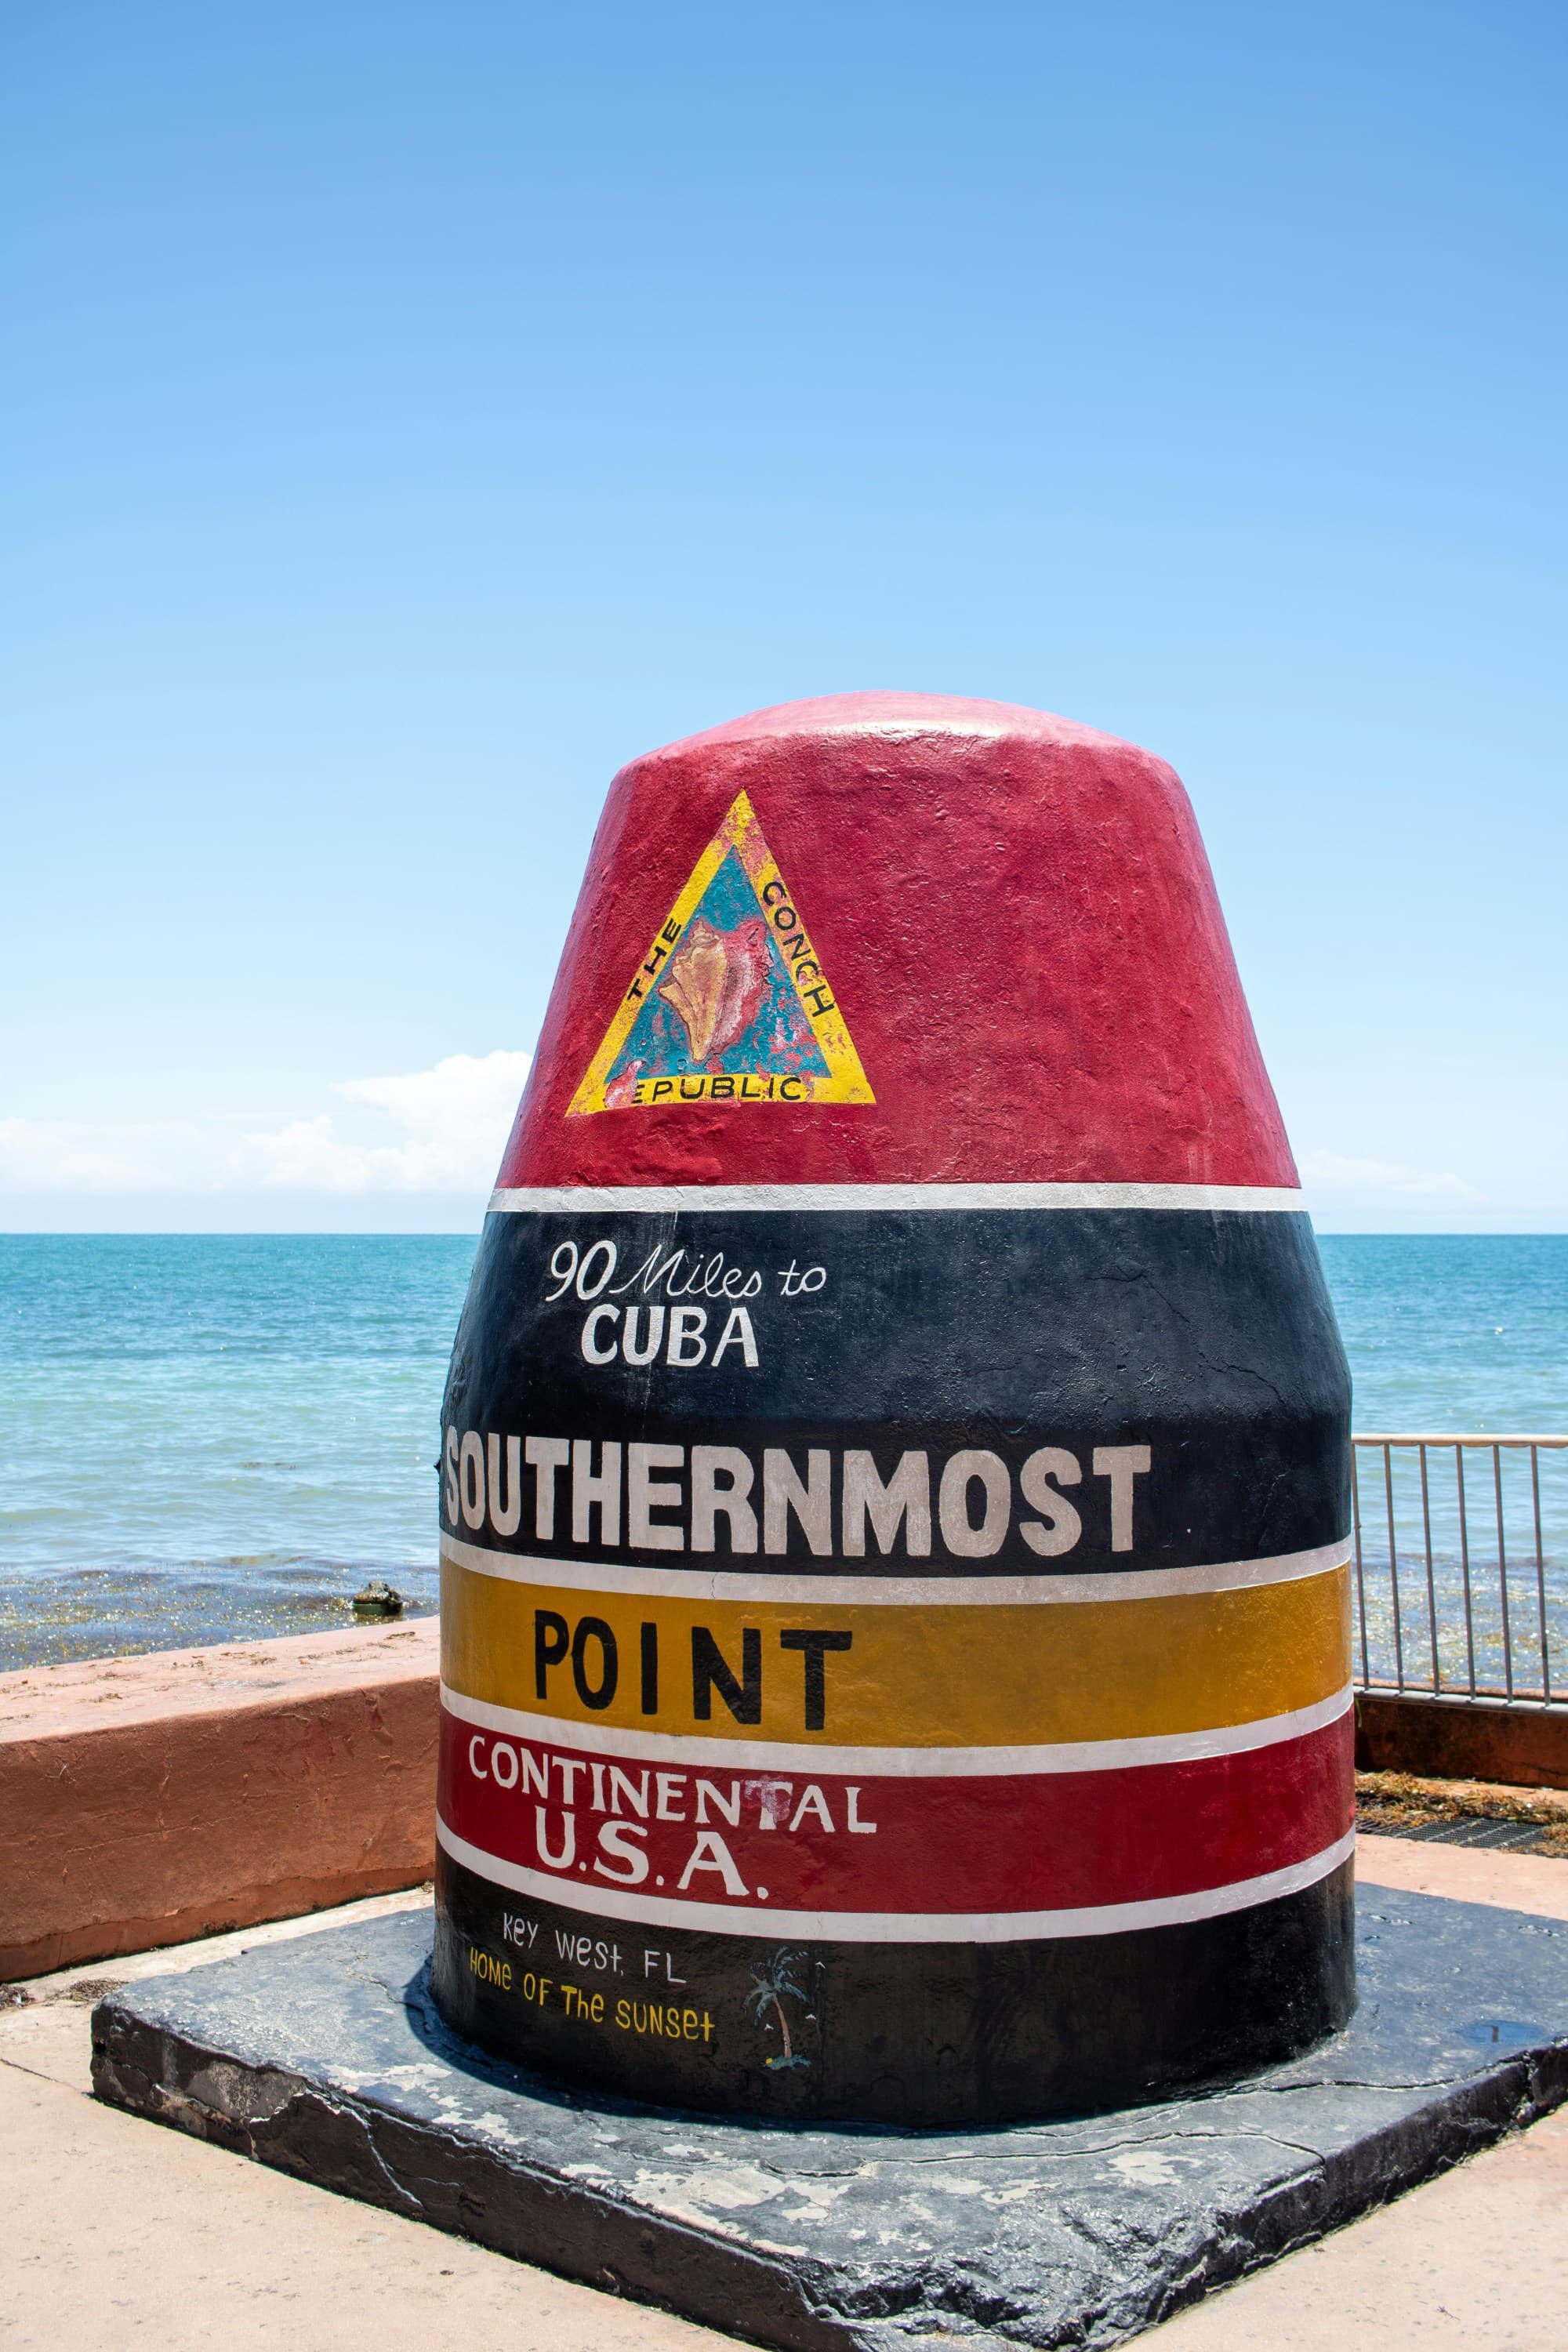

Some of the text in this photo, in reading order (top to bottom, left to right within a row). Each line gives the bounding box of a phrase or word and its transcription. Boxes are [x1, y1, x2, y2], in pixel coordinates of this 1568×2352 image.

[627, 918, 681, 1000] THE
[763, 880, 835, 1018] CONCH
[603, 1076, 804, 1109] EPUBLIC
[546, 1240, 827, 1301] 90 Miles to
[581, 1304, 760, 1368] CUBA
[446, 1425, 1152, 1557] SOUTHERNMOST
[534, 1609, 853, 1730] POINT
[469, 1735, 877, 1833] CONTINENTAL
[535, 1805, 769, 1900] U.S.A.
[523, 1973, 554, 2007] OF
[644, 1950, 687, 1984] FL
